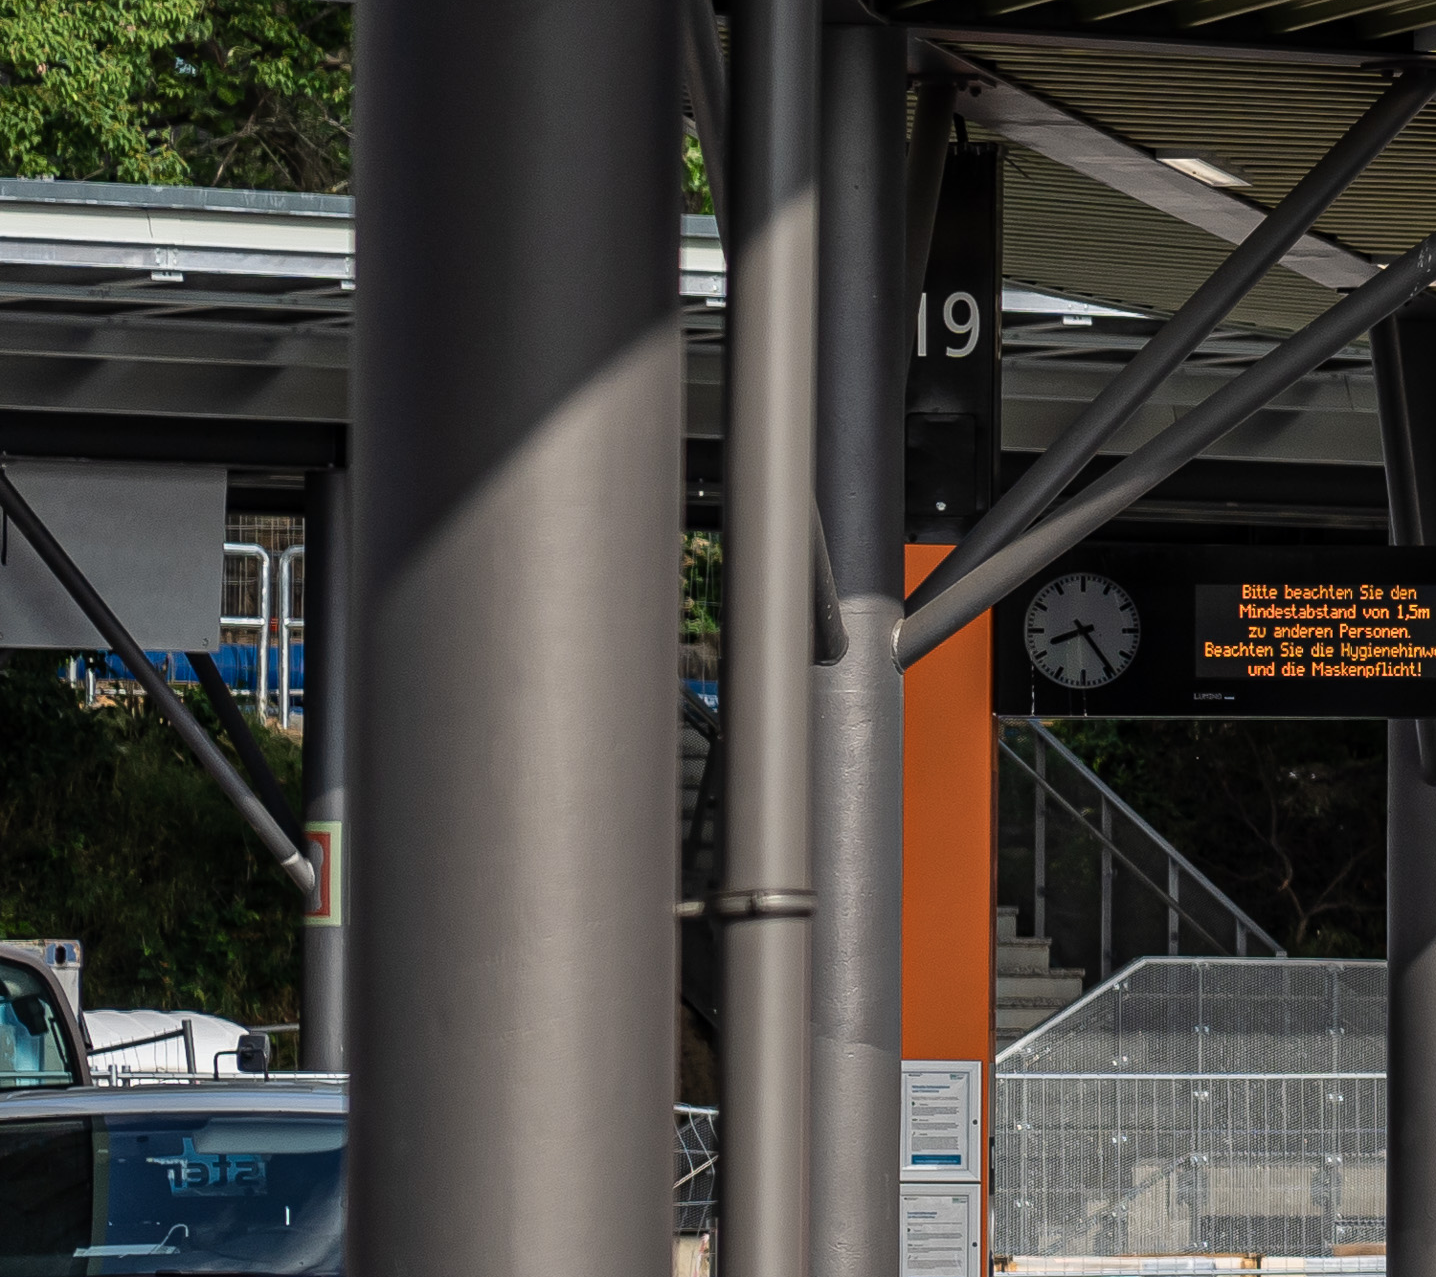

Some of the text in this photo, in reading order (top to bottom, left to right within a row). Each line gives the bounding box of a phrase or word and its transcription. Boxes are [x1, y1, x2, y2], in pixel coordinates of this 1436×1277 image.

[918, 291, 980, 357] 19
[1242, 584, 1417, 600] Bitte beachten Sie den
[1239, 604, 1430, 621] Mindestabstand von 1,5m
[1248, 623, 1411, 639] zu anderen Personen.
[1204, 642, 1273, 657] Beachten
[1280, 642, 1303, 657] Sie
[1311, 642, 1334, 658] die
[1247, 662, 1421, 678] und die Maskenpflicht!
